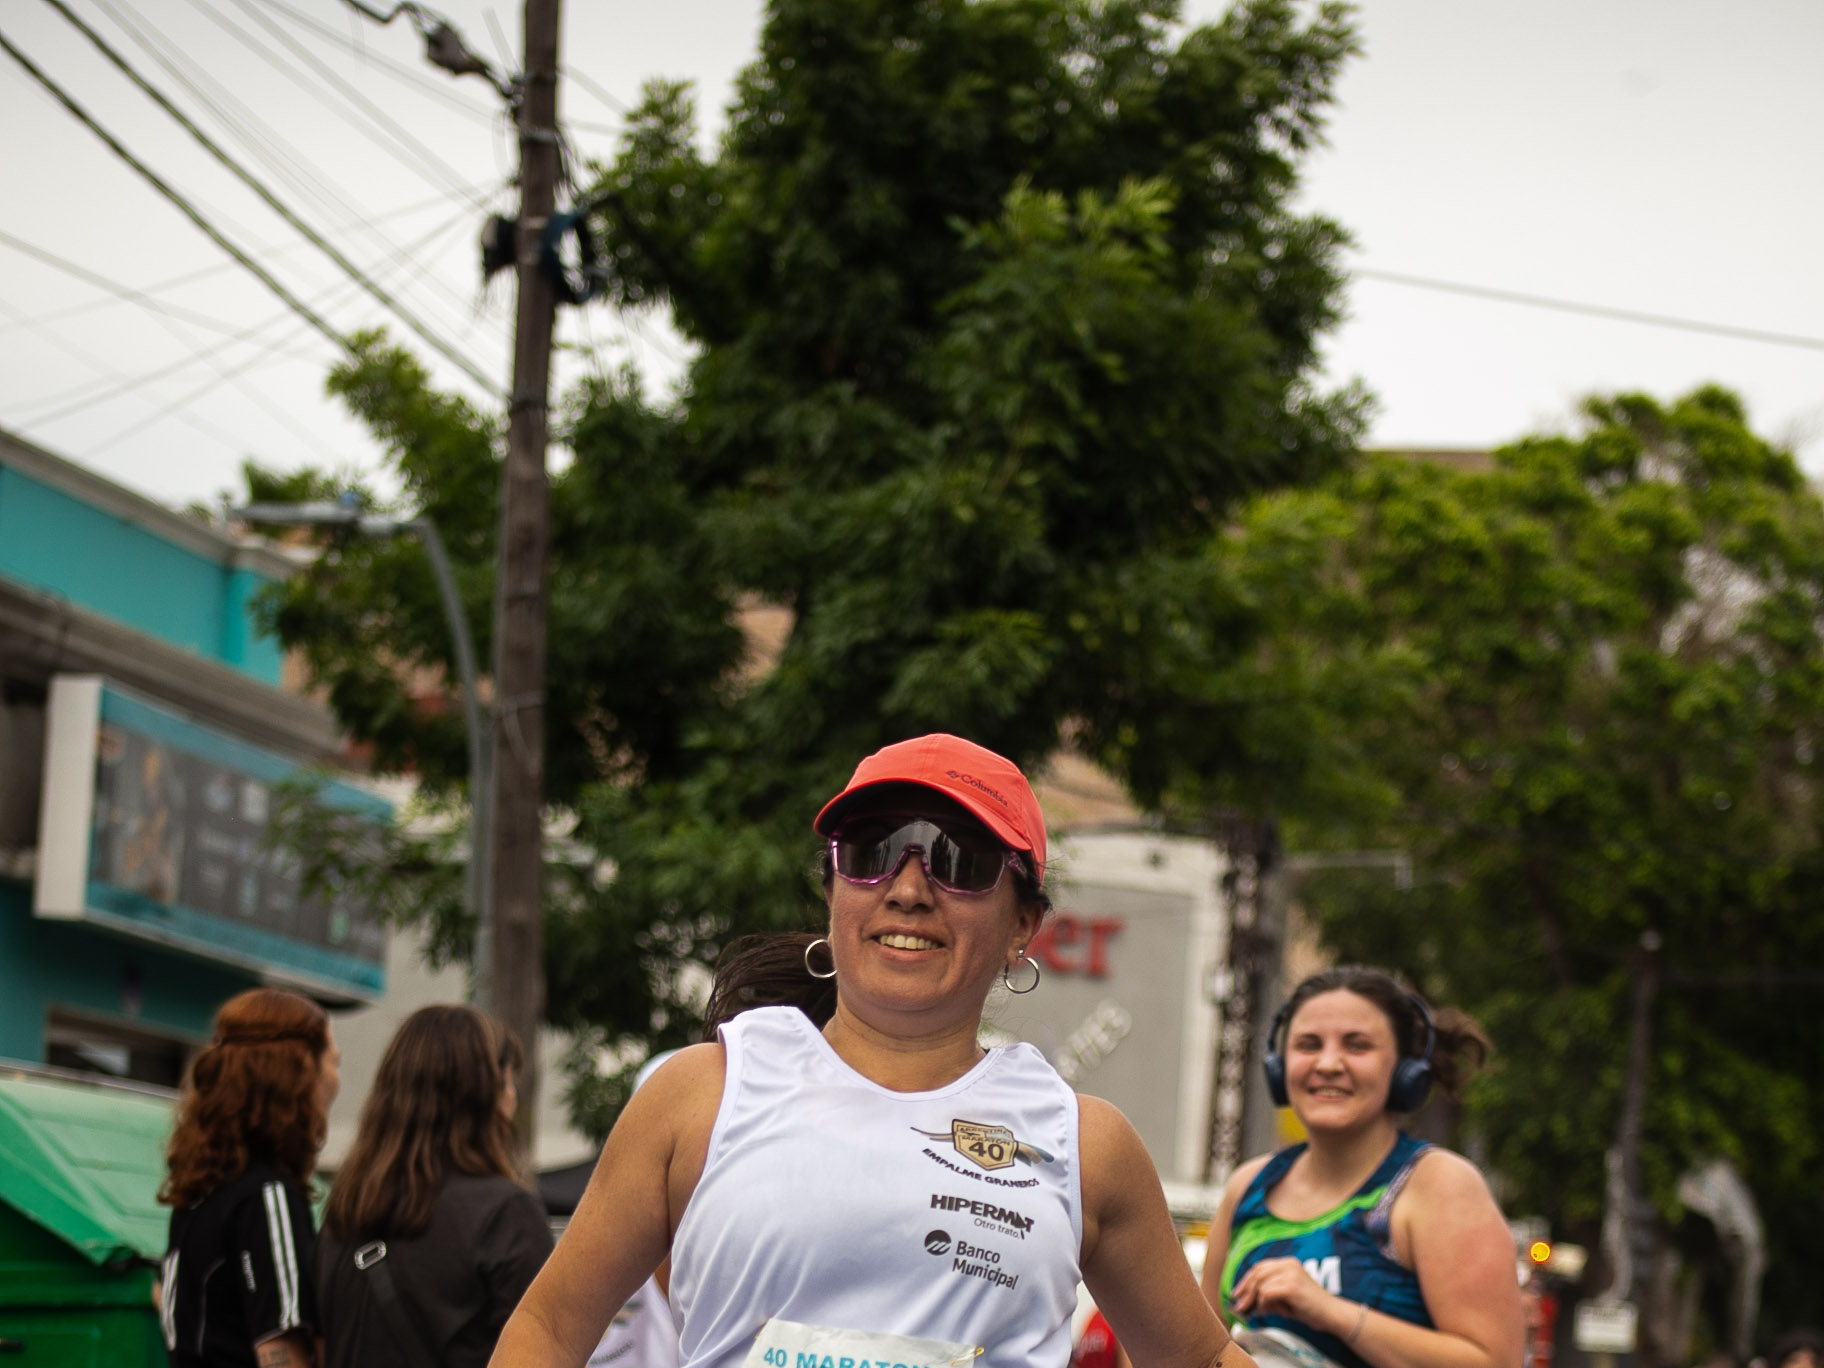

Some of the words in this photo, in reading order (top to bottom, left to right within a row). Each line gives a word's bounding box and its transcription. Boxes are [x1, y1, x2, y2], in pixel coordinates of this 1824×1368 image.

[961, 774, 1008, 807] Columbia
[922, 1148, 983, 1181] EMPALME
[968, 1141, 1005, 1162] 40
[930, 1194, 1035, 1234] HIPERMAT
[973, 1217, 997, 1231] Otro
[955, 1240, 1001, 1265] Banco
[951, 1258, 1020, 1291] Municipal
[763, 1346, 788, 1368] 40
